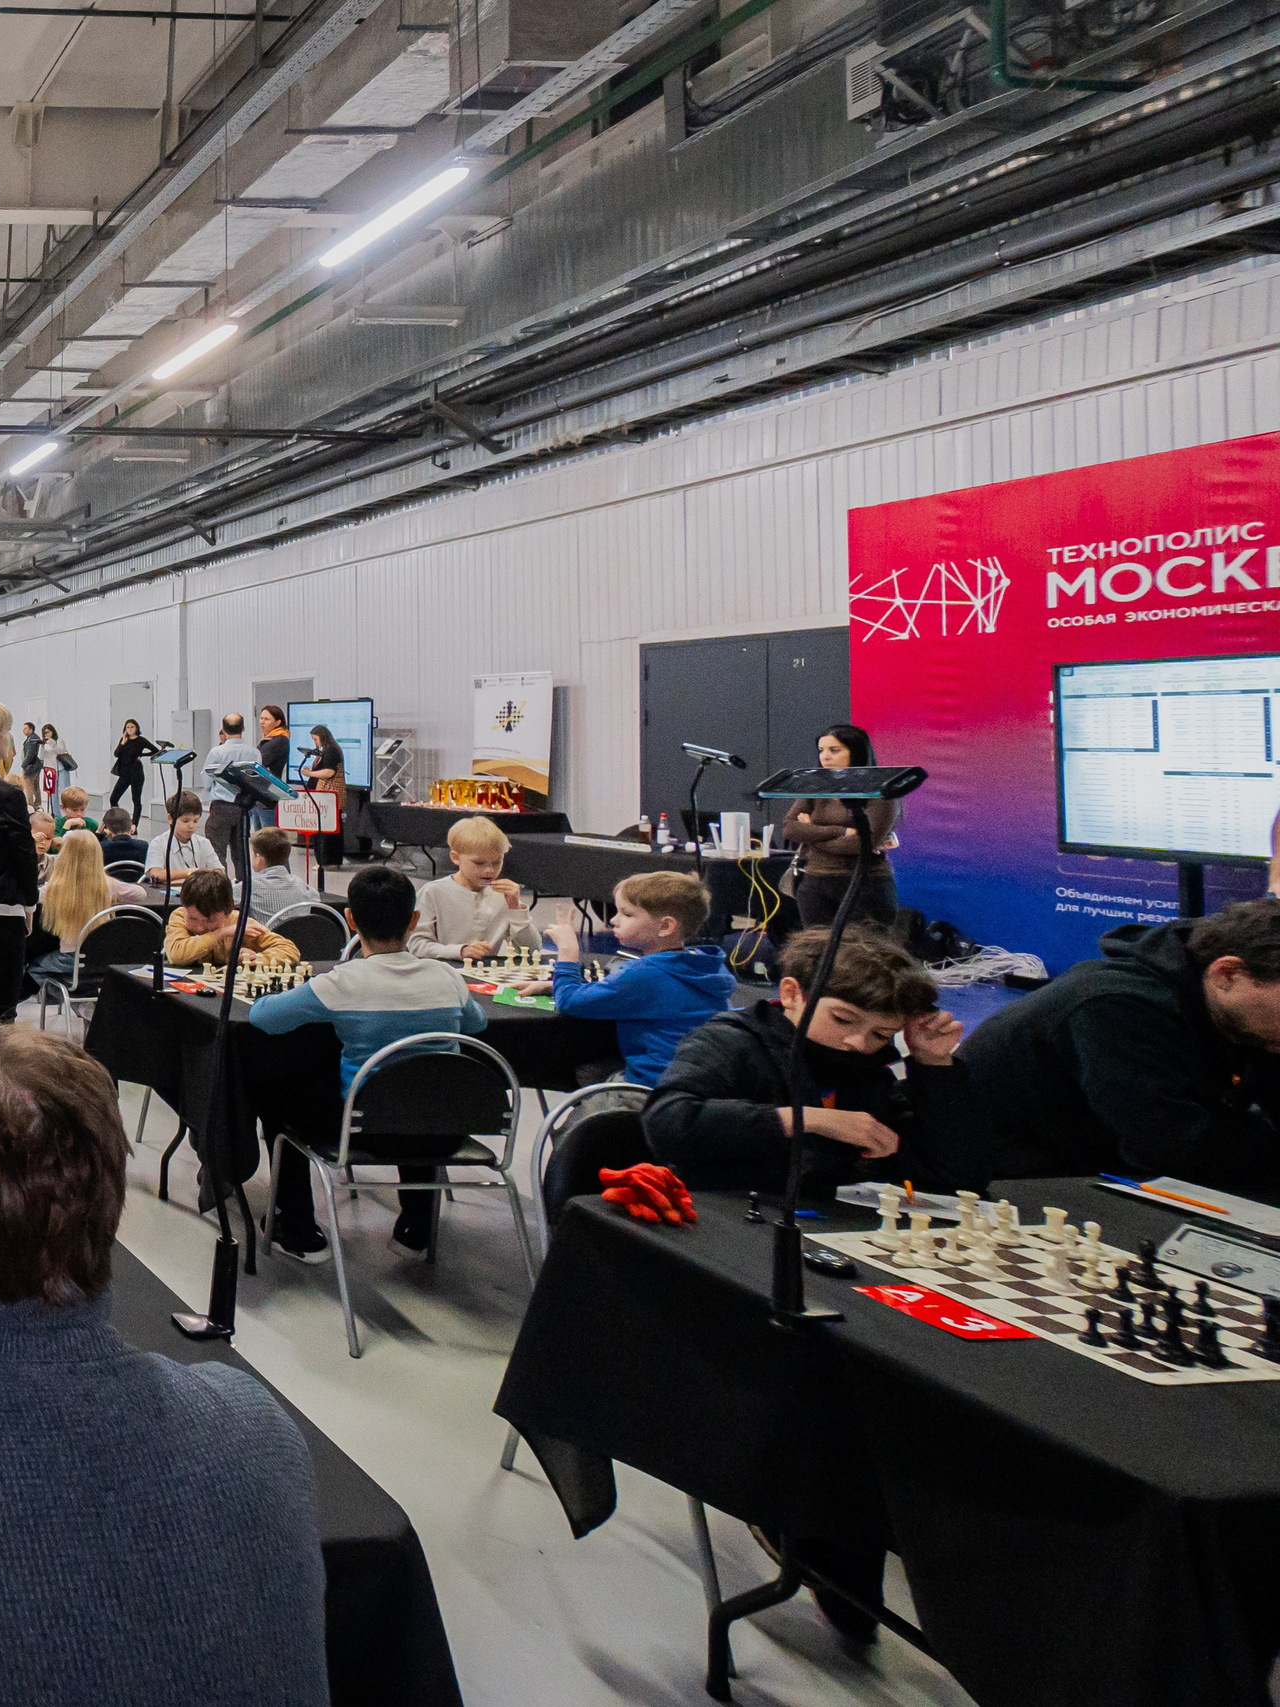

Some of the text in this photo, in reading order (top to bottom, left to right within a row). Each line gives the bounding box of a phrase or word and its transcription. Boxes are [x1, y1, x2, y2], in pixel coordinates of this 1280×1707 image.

[1046, 521, 1265, 565] ТЕХНОПОЛИС
[1047, 613, 1117, 629] ОСОБАЯ
[792, 657, 805, 669] 21
[45, 770, 53, 790] G
[283, 800, 307, 814] Grand
[294, 814, 317, 828] Chess
[1055, 886, 1143, 906] Объединяем
[1055, 902, 1080, 912] для
[1082, 906, 1134, 919] лучших
[884, 1288, 997, 1332] A 3
